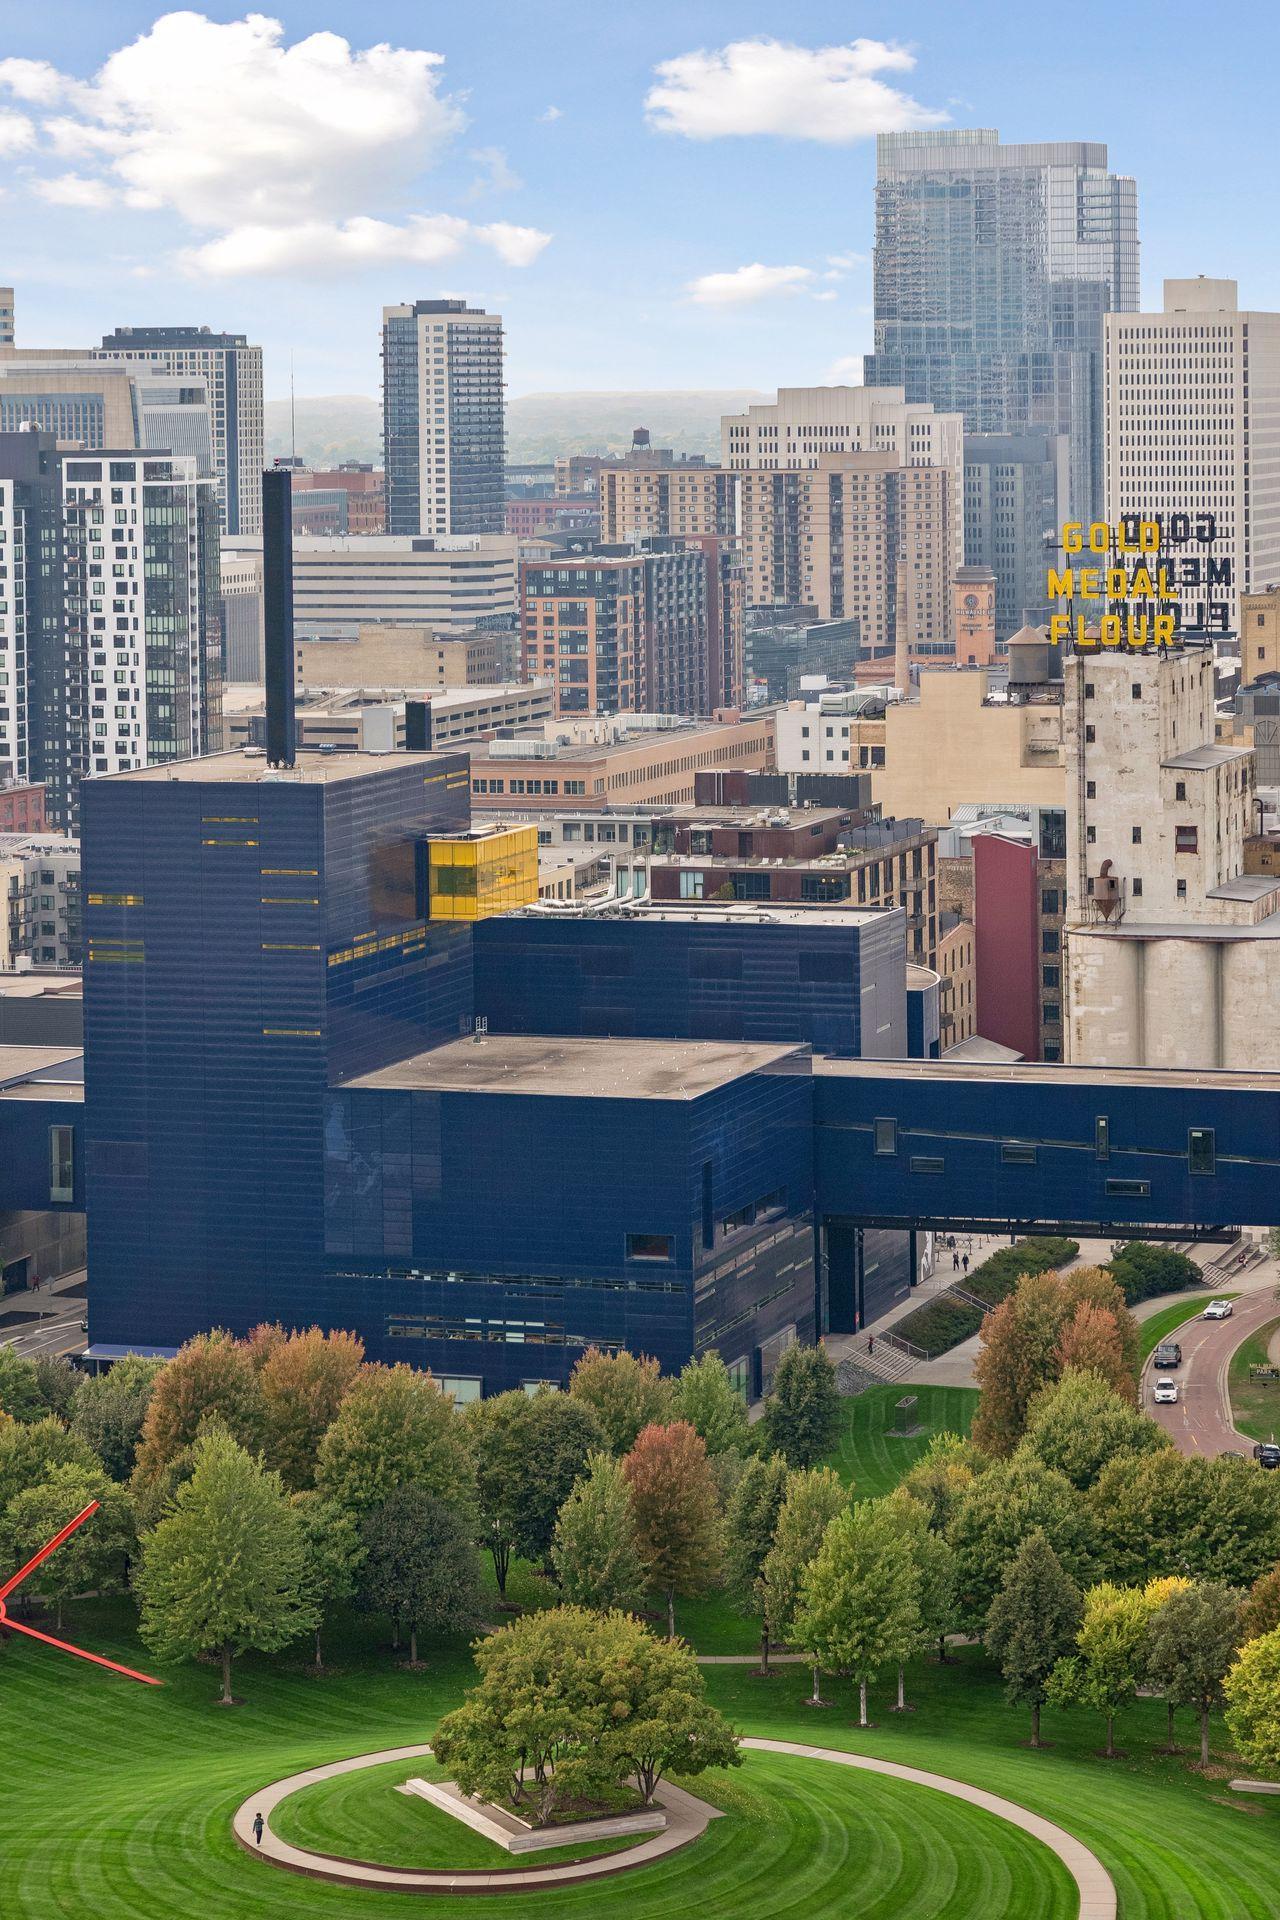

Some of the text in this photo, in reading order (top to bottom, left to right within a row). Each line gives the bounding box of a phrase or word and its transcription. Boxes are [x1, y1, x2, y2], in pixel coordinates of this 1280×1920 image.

[1062, 521, 1160, 554] GOLD
[1047, 567, 1178, 599] MEDAL
[1050, 614, 1175, 646] FLOUR
